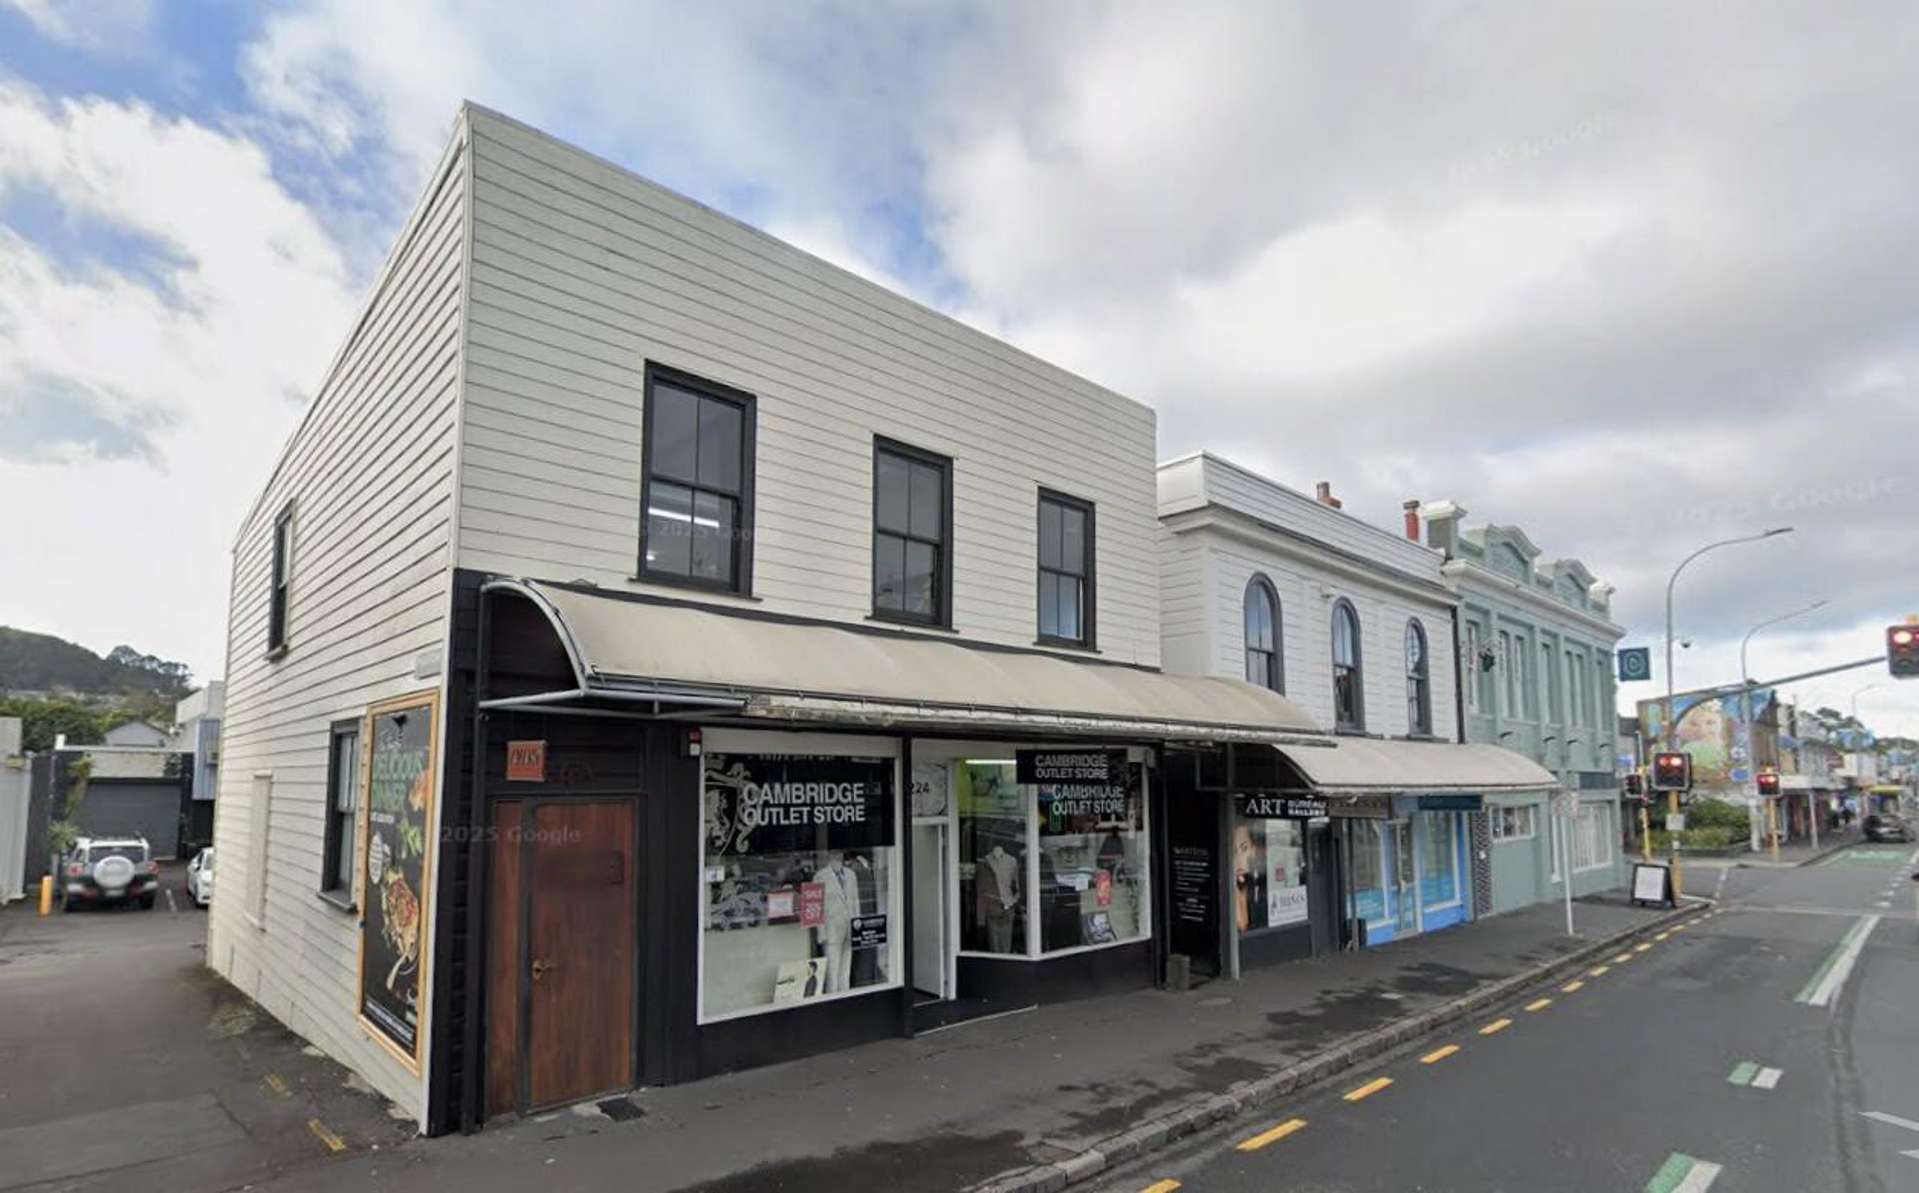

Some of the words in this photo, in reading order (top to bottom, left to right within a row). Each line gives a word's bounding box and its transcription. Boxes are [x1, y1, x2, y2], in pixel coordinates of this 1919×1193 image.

[1035, 754, 1109, 767] CAMBRIDGE
[1036, 767, 1073, 779] OUTLET
[1075, 767, 1109, 779] STORE
[743, 782, 865, 805] CAMBRIDGE
[1053, 783, 1125, 800] CAMBRIDGE
[743, 807, 811, 826] OUTLET
[813, 804, 866, 824] STORE
[1052, 801, 1091, 816] OUTLET
[1093, 798, 1125, 814] STORE
[1246, 799, 1286, 815] ART
